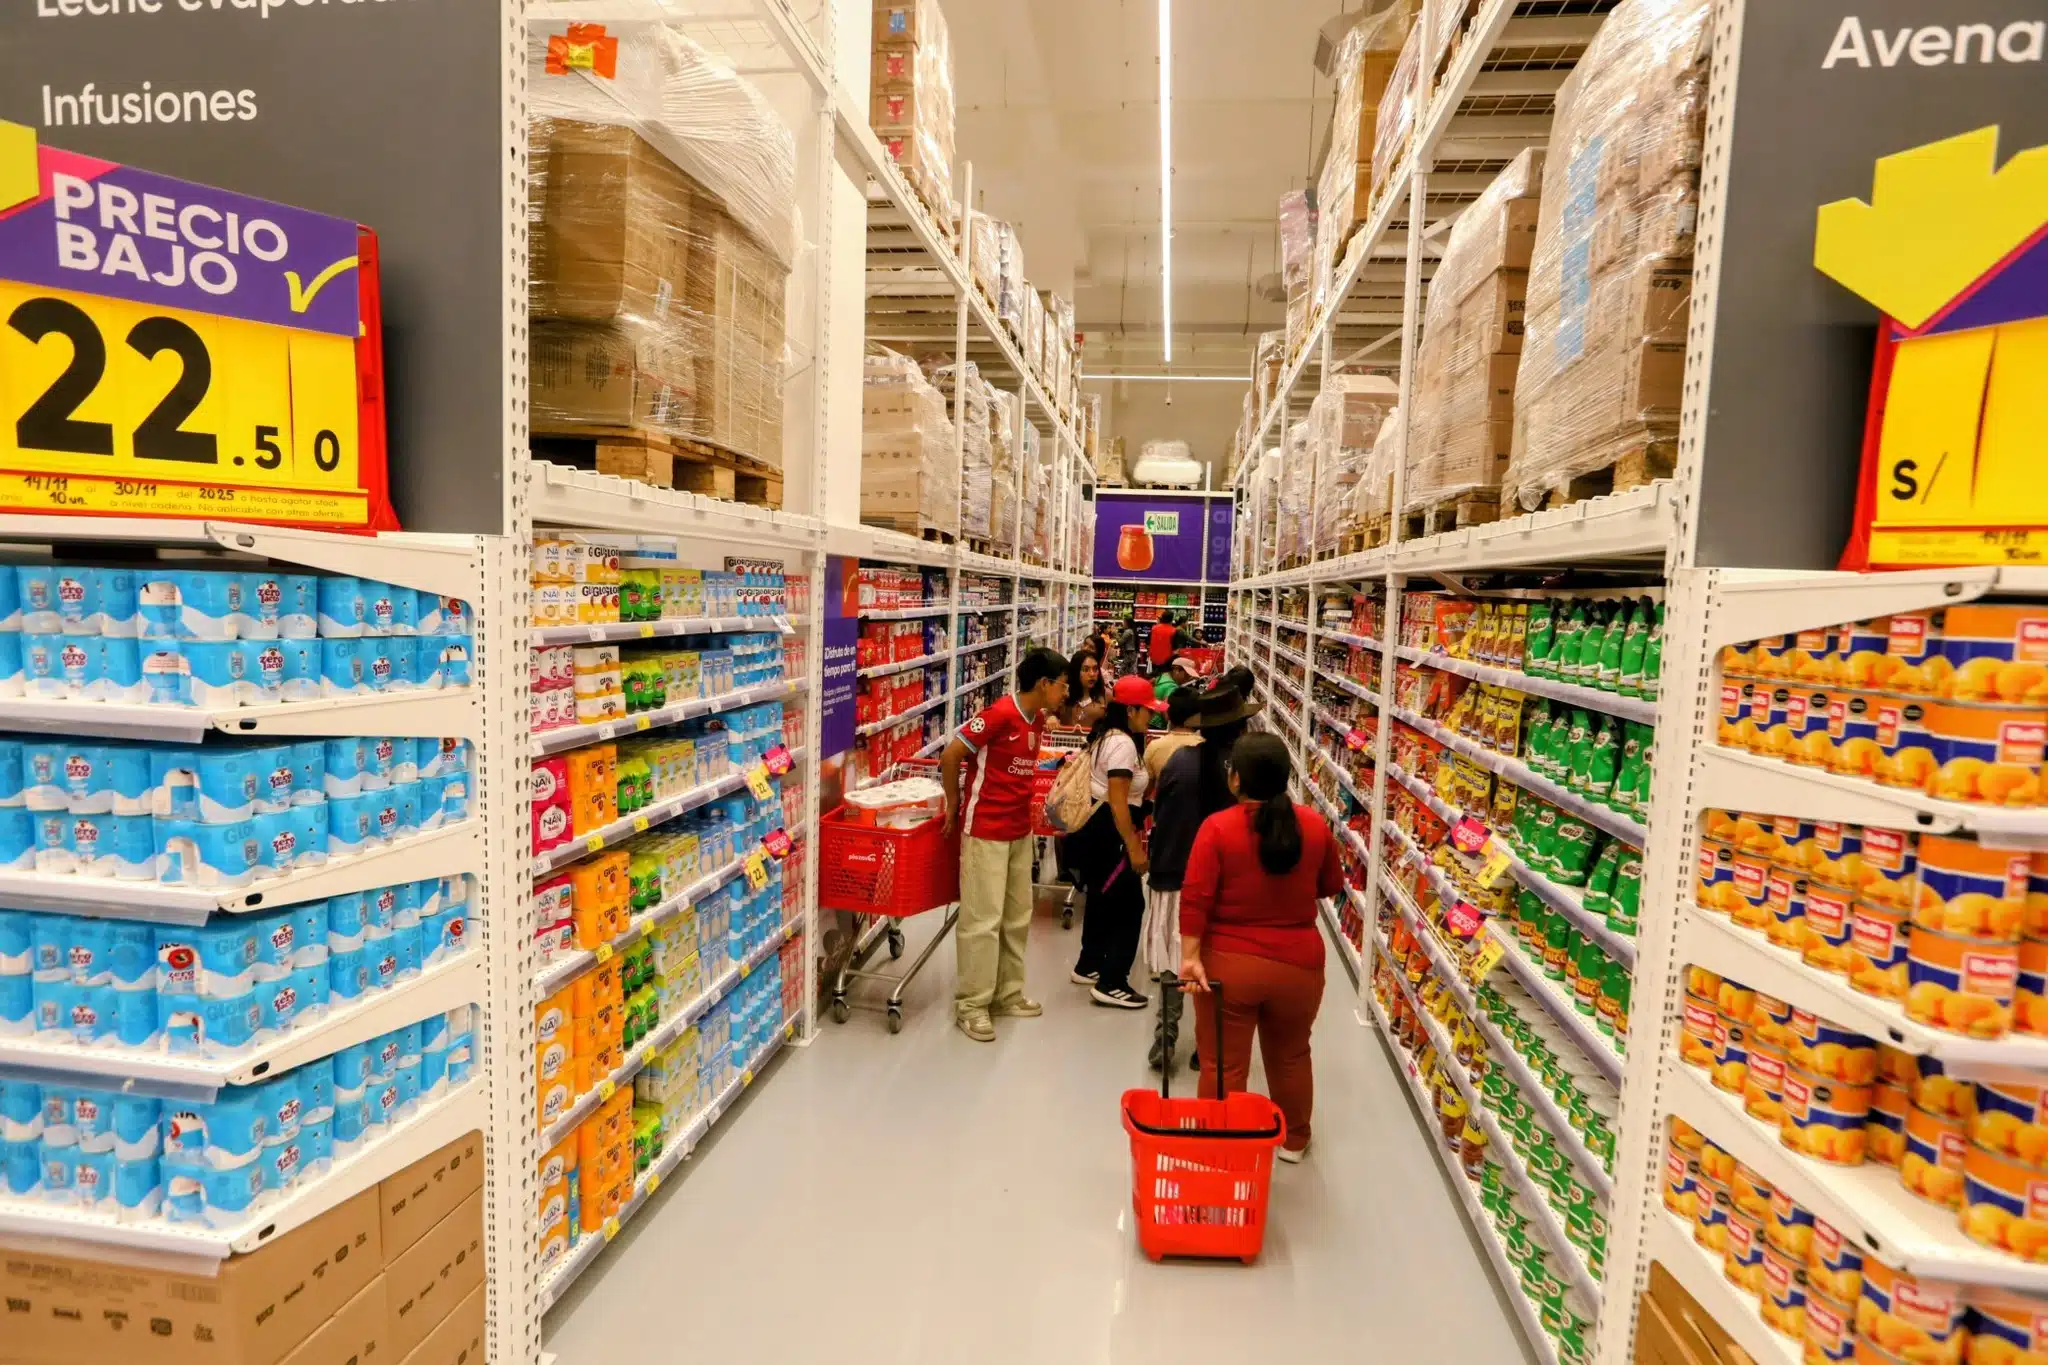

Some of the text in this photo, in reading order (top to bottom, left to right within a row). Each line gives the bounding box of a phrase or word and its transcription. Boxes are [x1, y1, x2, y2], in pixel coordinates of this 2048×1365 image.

[1821, 16, 2044, 70] Avena
[42, 81, 257, 126] Infusiones
[52, 172, 289, 263] PRECIO
[56, 221, 238, 295] BAJO
[50, 491, 67, 504] 10
[114, 481, 157, 497] 30/11
[200, 488, 235, 501] 2025
[1157, 514, 1176, 531] SALIDA
[256, 587, 281, 597] zero
[259, 655, 283, 665] zero
[543, 812, 562, 827] NAN
[272, 931, 293, 943] zero
[273, 993, 296, 1005] zero
